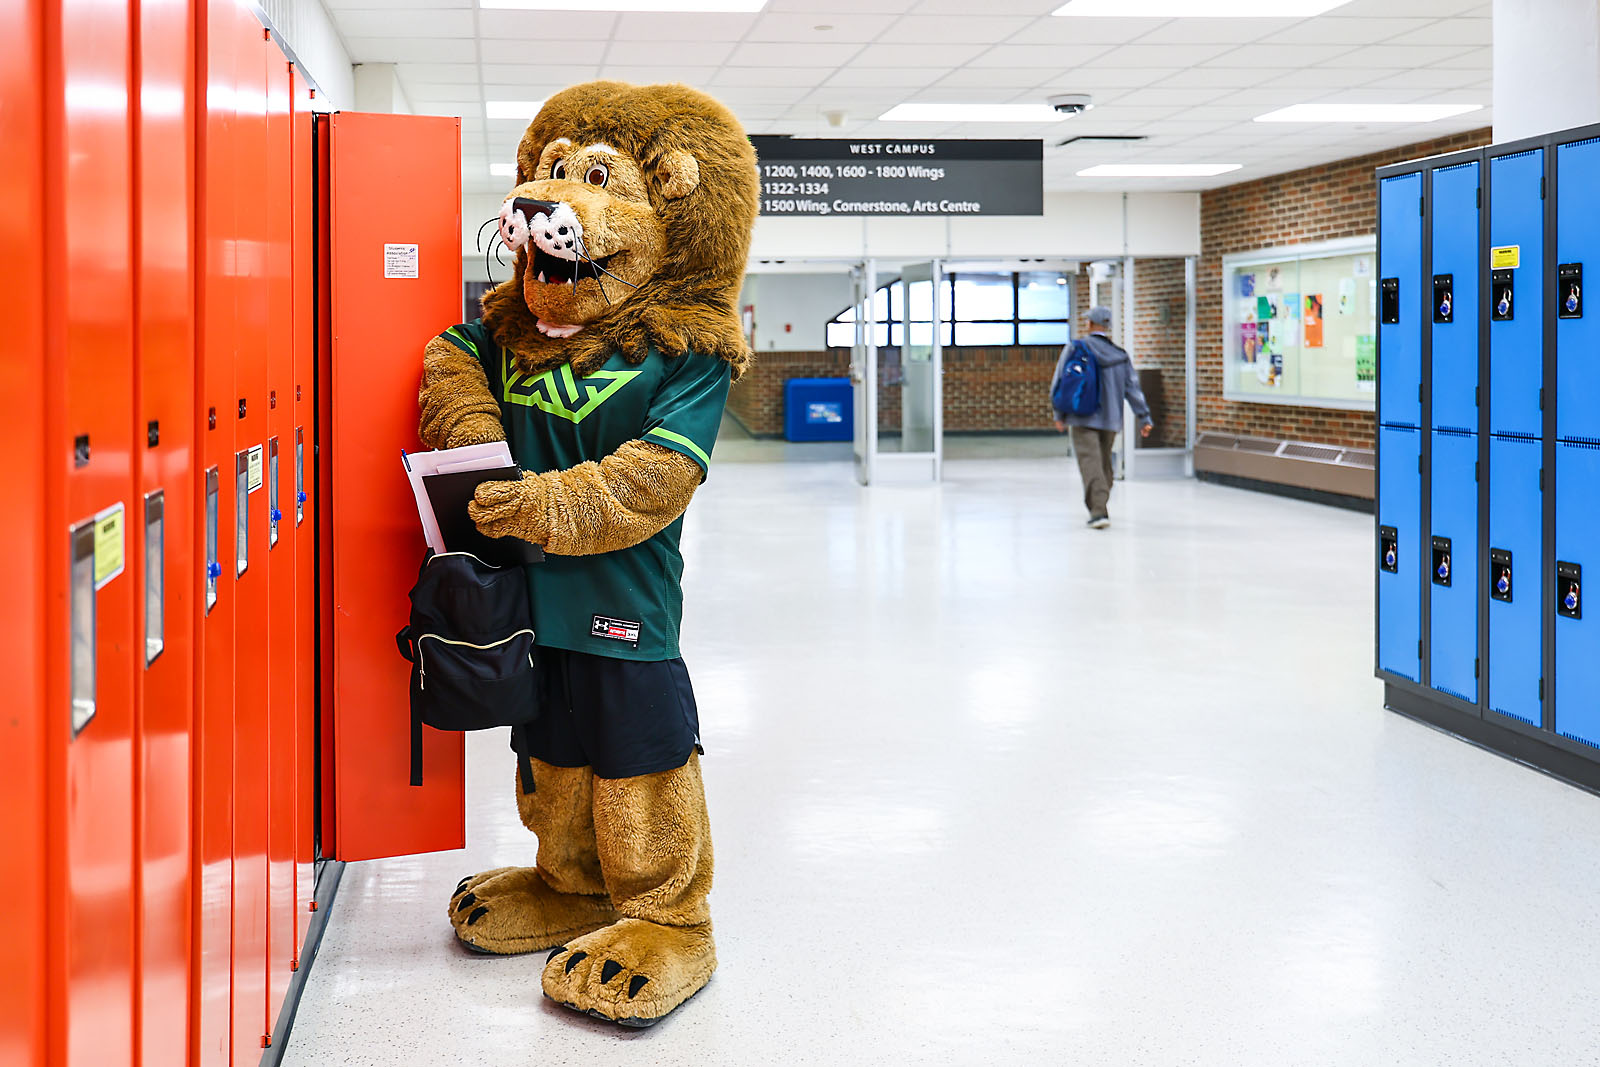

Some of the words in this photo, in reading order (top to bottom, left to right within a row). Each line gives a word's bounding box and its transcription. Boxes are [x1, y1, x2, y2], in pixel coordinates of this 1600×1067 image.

[849, 144, 881, 154] WEST
[885, 144, 935, 154] CAMPUS
[764, 165, 798, 178] 1200,
[800, 165, 834, 178] 1400,
[836, 165, 866, 177] 1600
[875, 165, 906, 177] 1800
[907, 165, 945, 180] Wings
[764, 182, 829, 195] 1322-1334
[764, 200, 795, 212] 1500
[796, 200, 831, 214] Wing,
[833, 200, 910, 213] Cornerstone,
[912, 200, 938, 212] Arts
[939, 200, 981, 212] Centre
